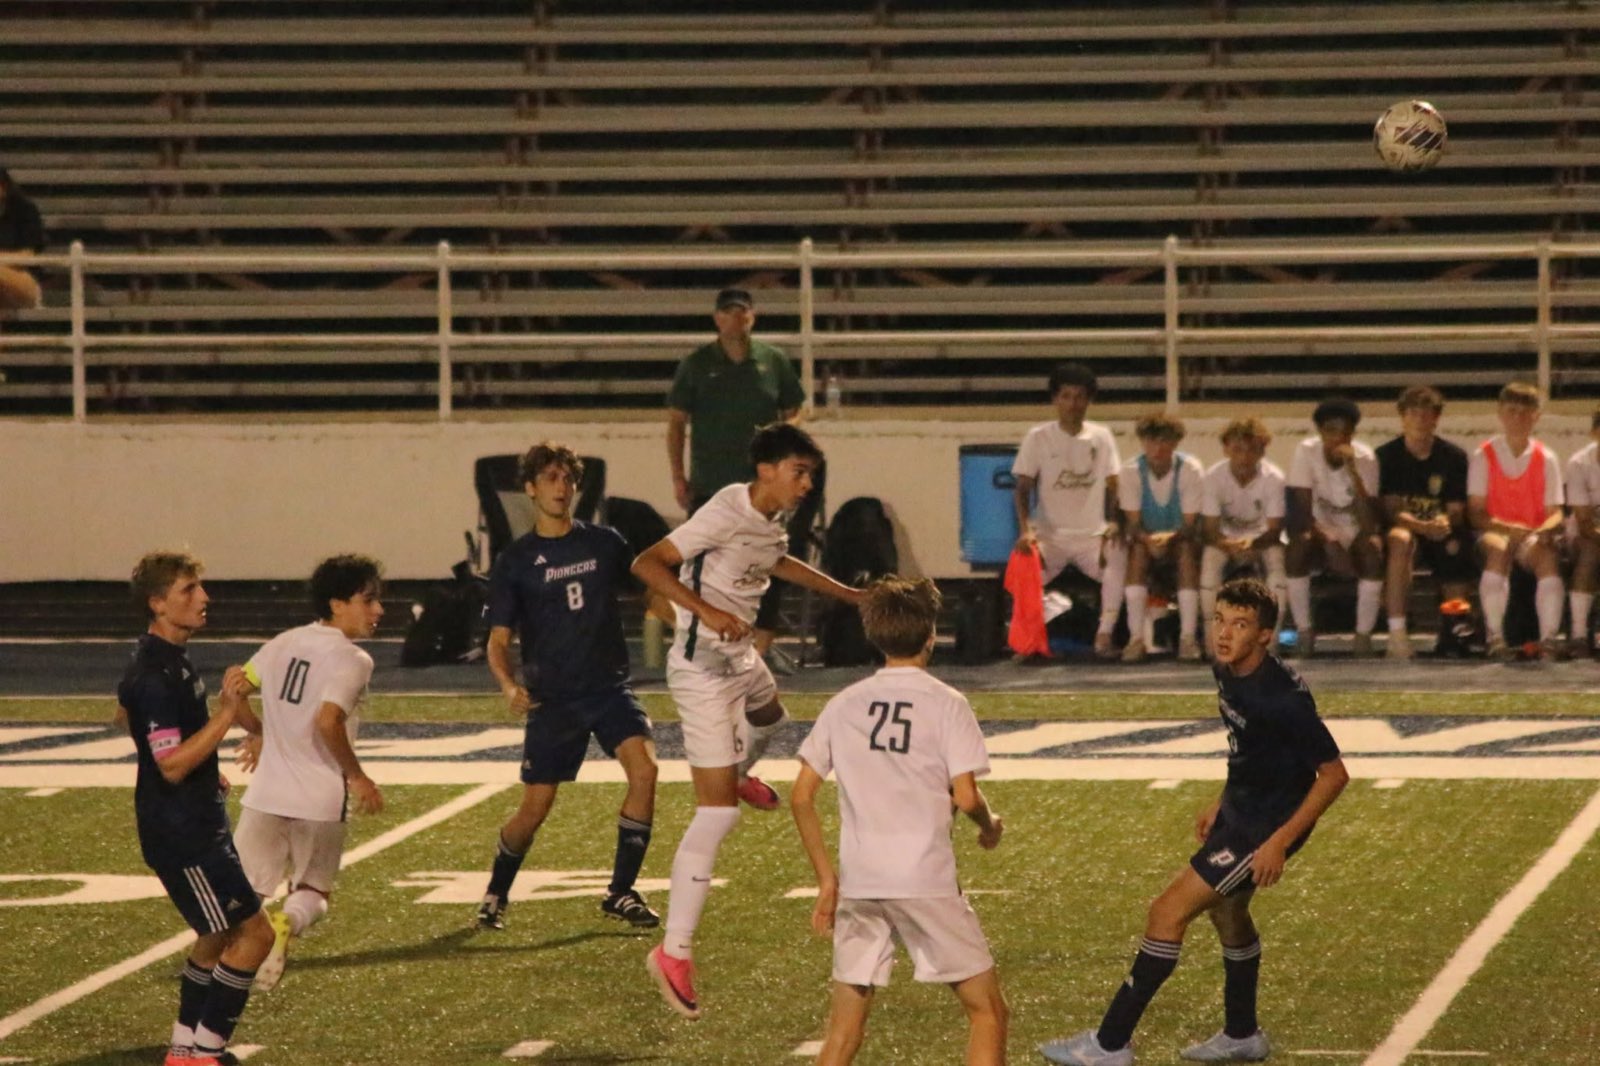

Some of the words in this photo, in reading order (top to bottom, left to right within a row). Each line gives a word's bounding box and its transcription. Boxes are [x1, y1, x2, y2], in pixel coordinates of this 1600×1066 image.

[545, 558, 597, 582] PIONEERS
[566, 582, 584, 610] 8
[279, 657, 311, 704] 10
[868, 701, 913, 755] 25
